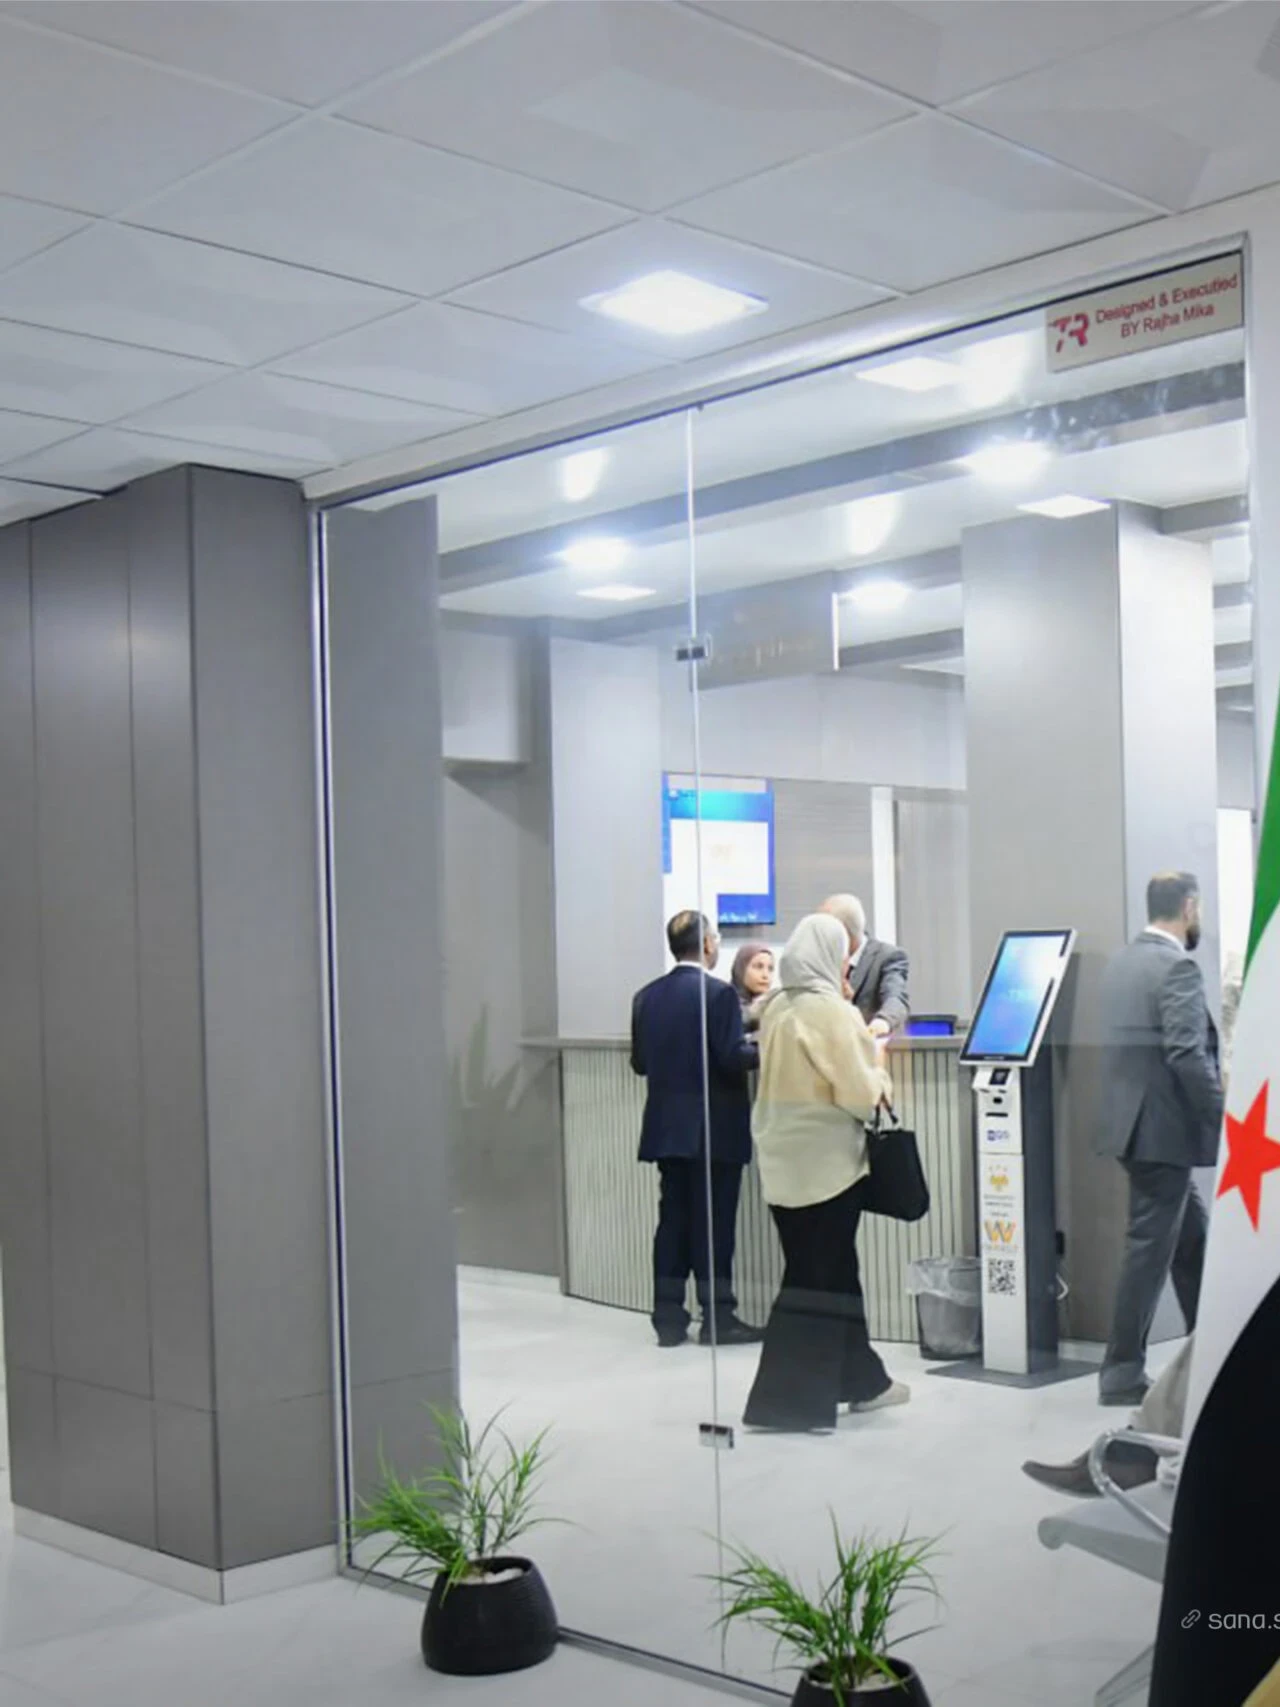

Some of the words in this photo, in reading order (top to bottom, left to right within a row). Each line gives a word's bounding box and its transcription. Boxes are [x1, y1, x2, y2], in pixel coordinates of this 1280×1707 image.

[1095, 296, 1156, 324] Designed
[1158, 290, 1170, 308] &
[1120, 320, 1141, 339] BY
[1182, 302, 1215, 322] Mika
